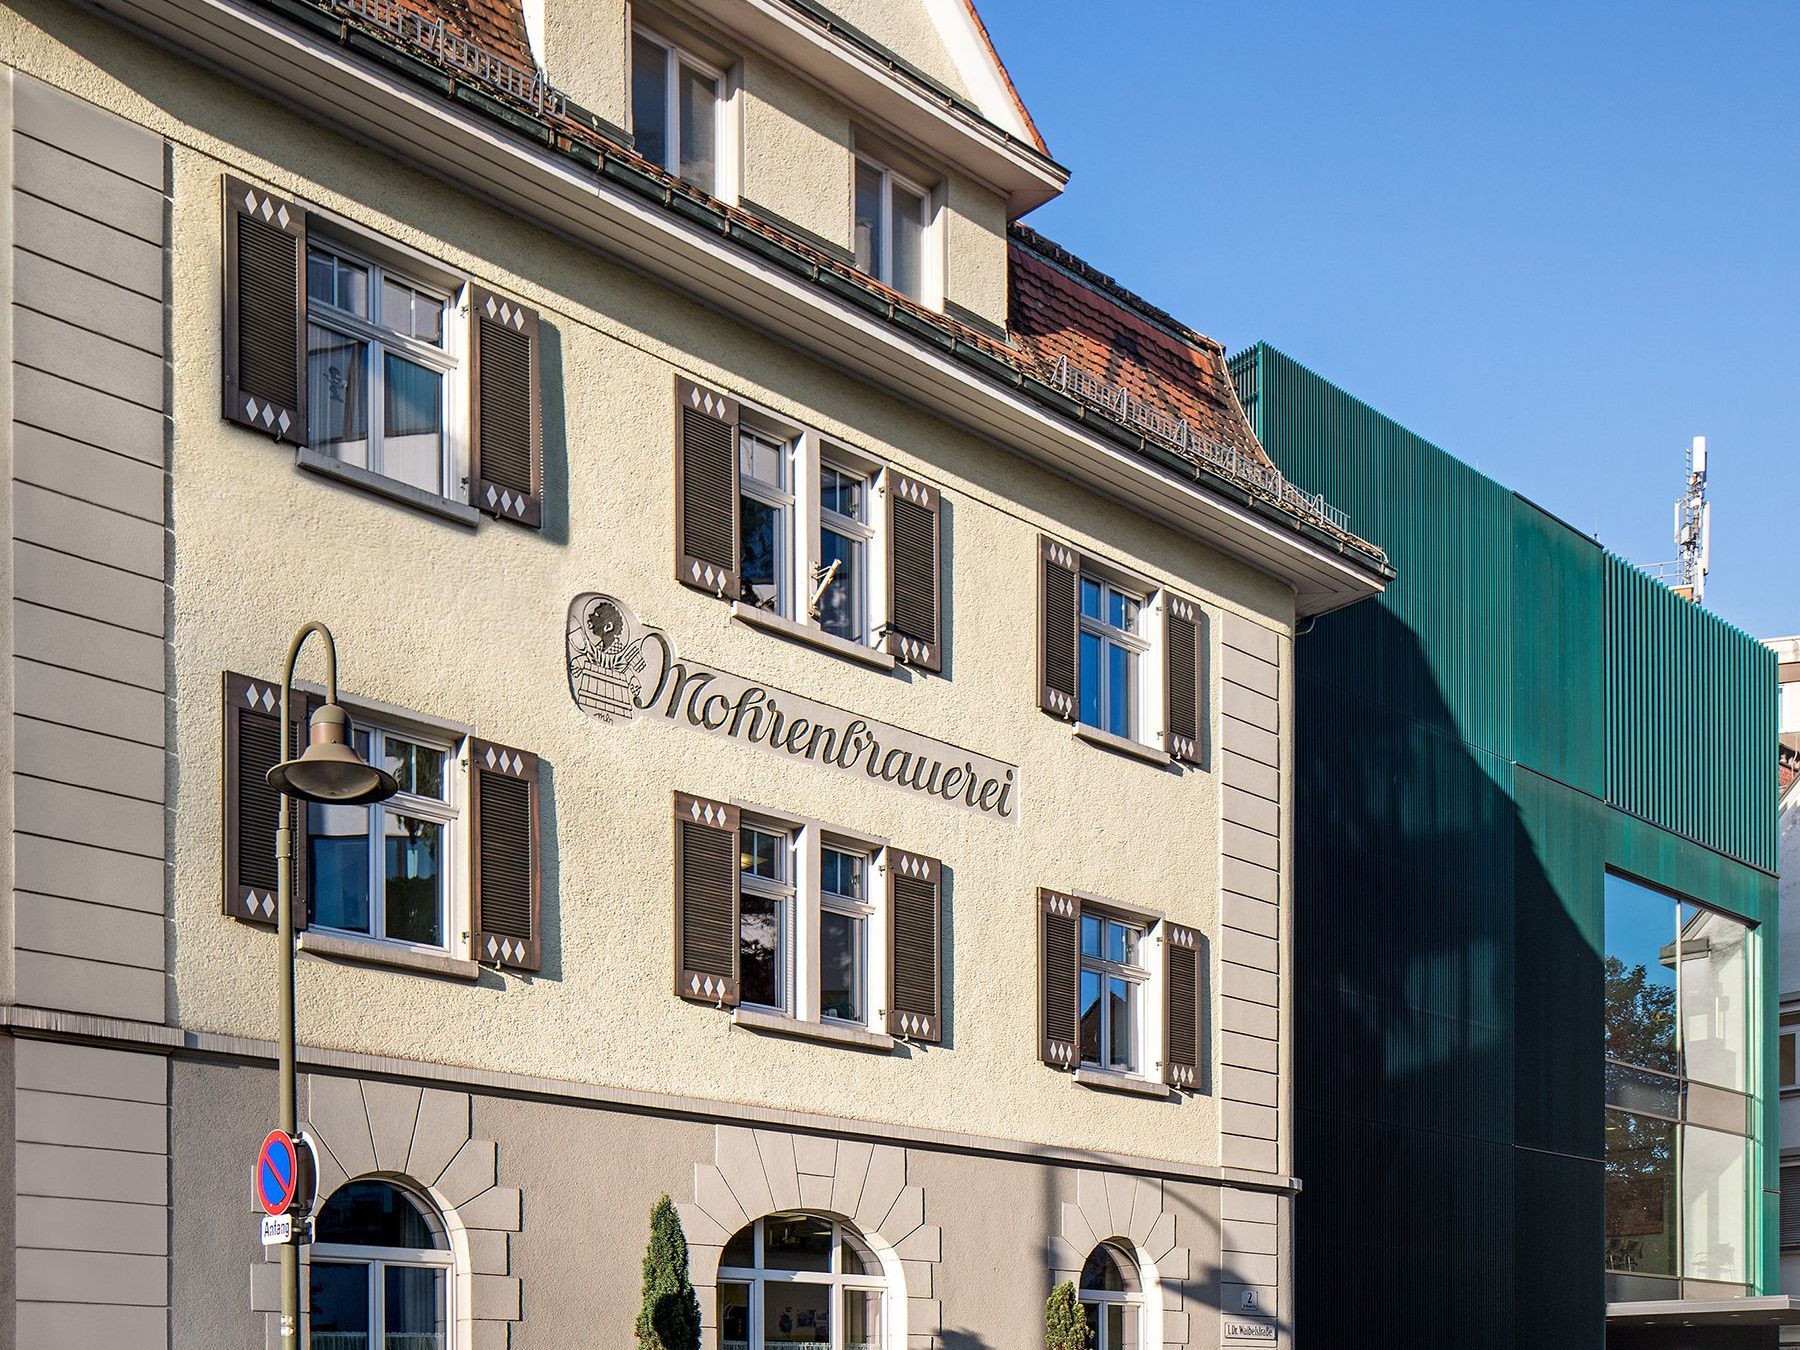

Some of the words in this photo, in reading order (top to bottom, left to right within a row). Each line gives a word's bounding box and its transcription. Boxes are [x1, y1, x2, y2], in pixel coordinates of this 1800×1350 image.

[633, 632, 1014, 817] Mohrenbrauerei
[264, 1219, 290, 1238] Anfang
[1247, 1292, 1253, 1303] 2
